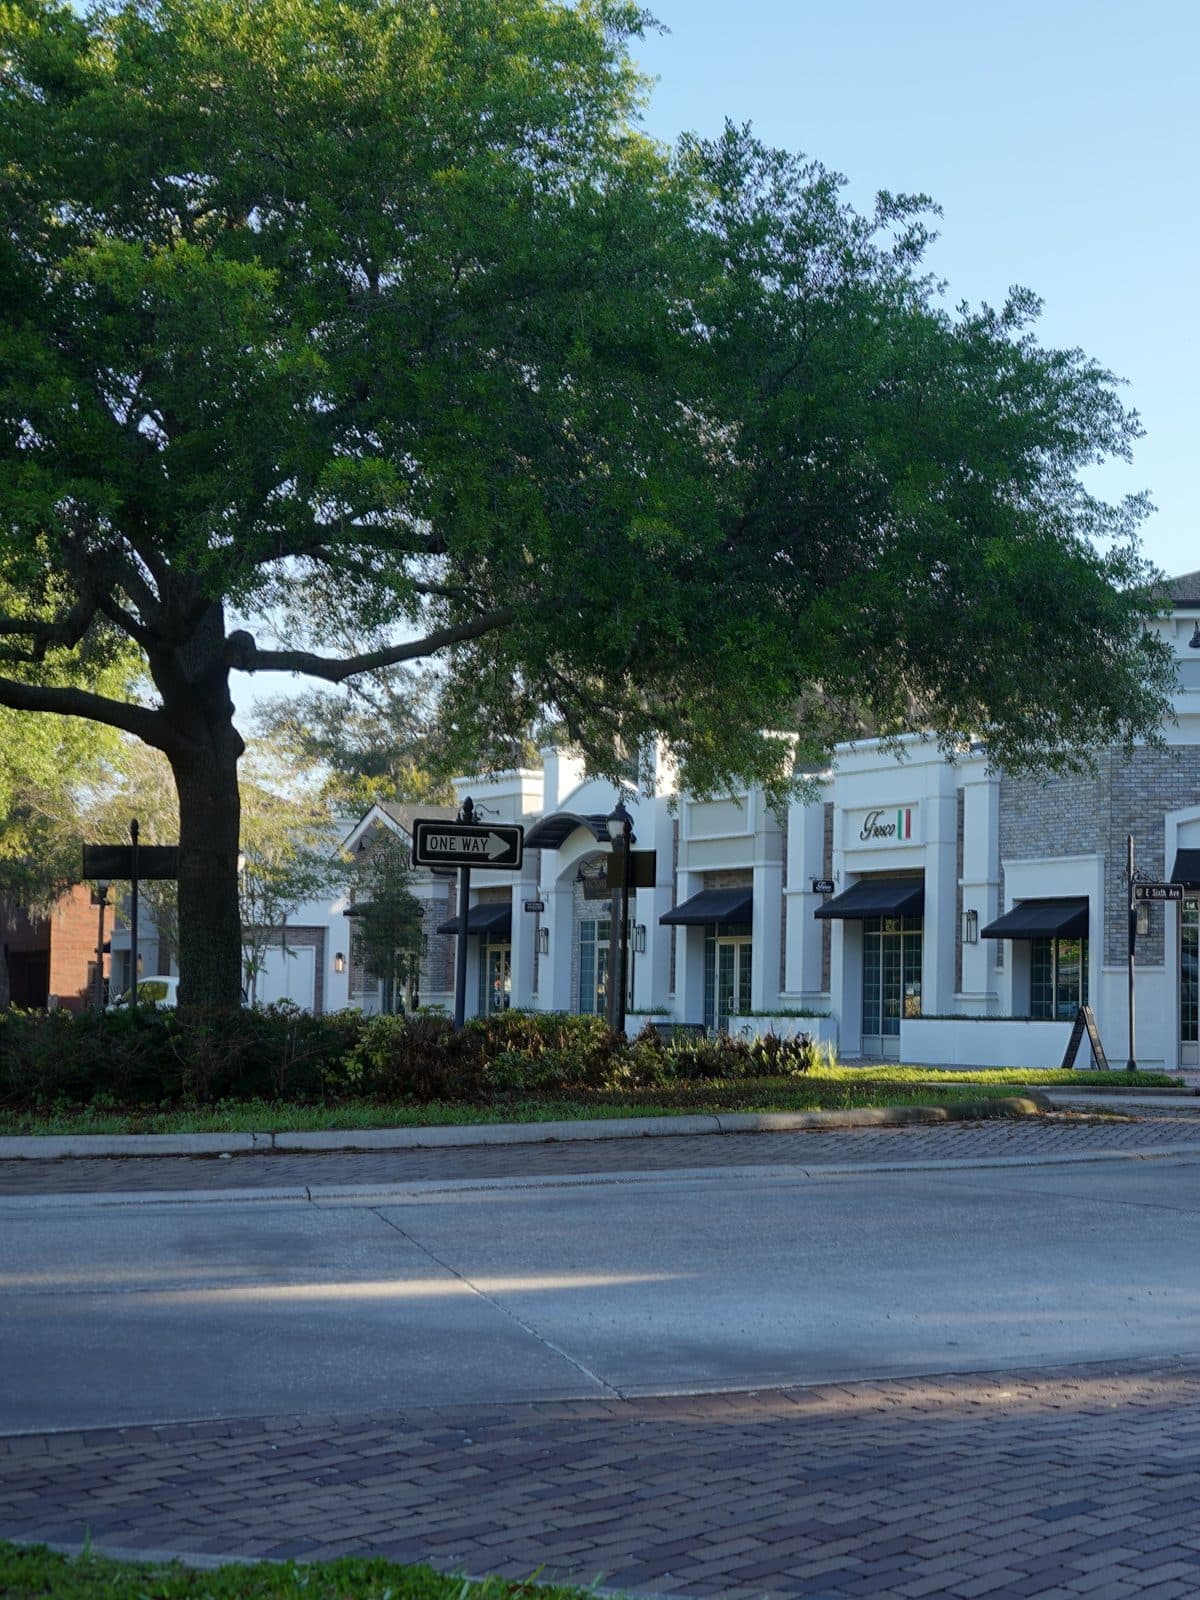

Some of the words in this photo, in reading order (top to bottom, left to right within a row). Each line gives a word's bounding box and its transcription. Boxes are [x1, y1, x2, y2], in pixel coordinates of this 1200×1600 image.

[860, 810, 896, 840] Fresco
[430, 836, 456, 851] ONE
[462, 838, 488, 852] WAY
[1152, 888, 1166, 897] Sixth
[1169, 888, 1180, 897] Ave
